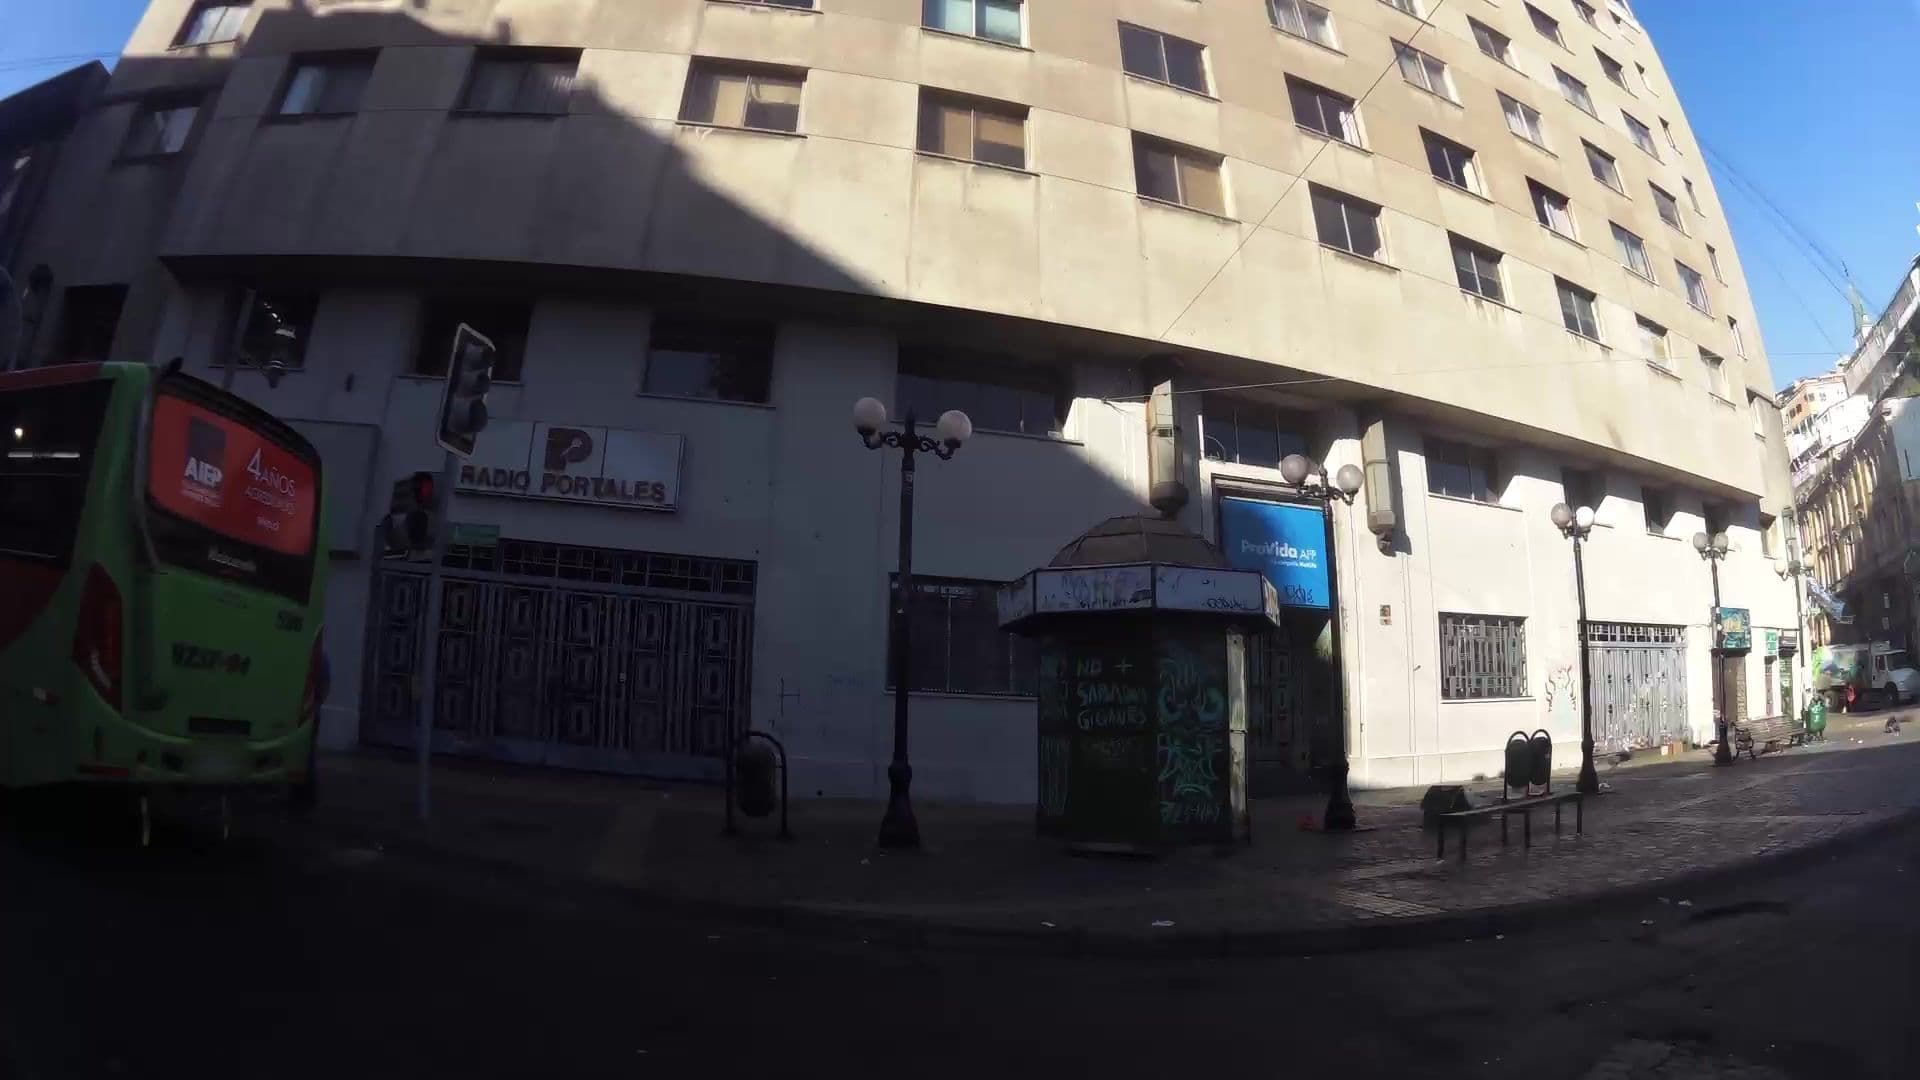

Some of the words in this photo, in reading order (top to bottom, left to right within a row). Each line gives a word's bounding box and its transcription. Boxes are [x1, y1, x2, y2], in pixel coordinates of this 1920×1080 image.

[183, 455, 223, 489] AIEP
[460, 464, 530, 490] RADIO
[541, 472, 665, 502] PORTALES
[1241, 538, 1298, 559] ProVida
